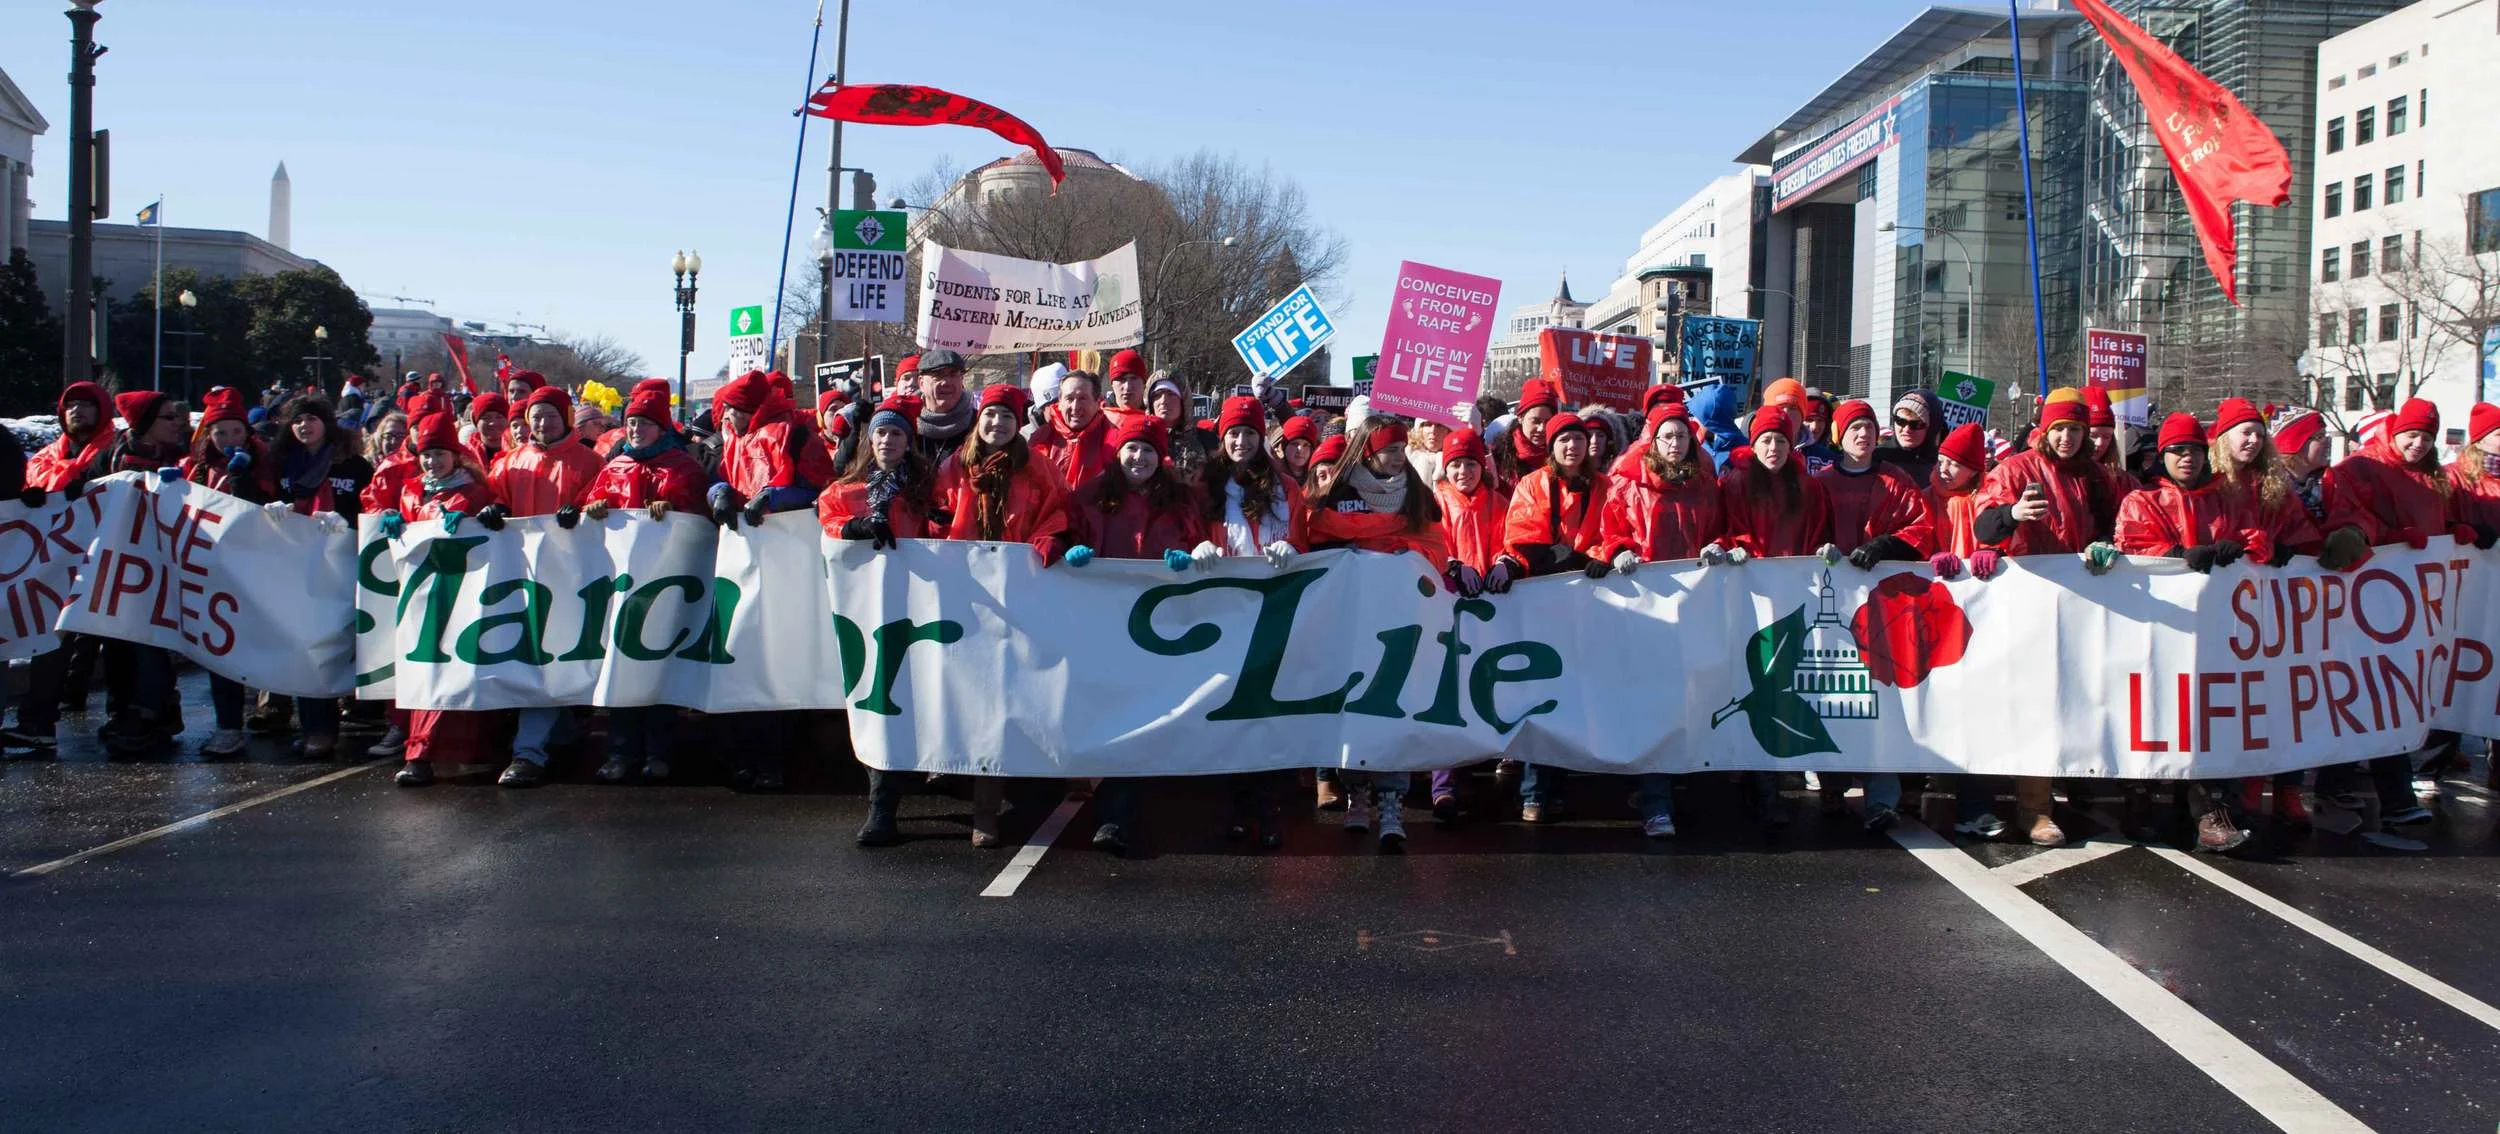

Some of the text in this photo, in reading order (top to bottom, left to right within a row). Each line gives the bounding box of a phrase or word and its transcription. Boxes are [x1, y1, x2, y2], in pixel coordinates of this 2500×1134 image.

[1780, 120, 1880, 199] NEWSEUM CELEBRATES FREEDOM
[834, 252, 904, 280] DEFEND
[850, 283, 886, 310] LIFE
[1400, 277, 1493, 306] CONCEIVED
[1419, 297, 1466, 318] FROM
[1240, 340, 1249, 350] I
[1246, 312, 1285, 346] STAND
[1282, 293, 1309, 318] FOR
[1417, 314, 1462, 334] RAPE
[730, 337, 764, 358] DEFEND
[1247, 302, 1328, 374] LIFE
[1396, 338, 1472, 364] I LOVE MY
[1700, 340, 1741, 352] FARGO
[2090, 336, 2145, 354] Life is a
[1571, 338, 1637, 369] LIFE
[1703, 356, 1745, 369] CAME
[2090, 350, 2140, 368] human
[1390, 352, 1468, 393] LIFE
[2090, 364, 2128, 381] right.
[1354, 381, 1373, 397] DEF
[130, 479, 222, 577] THE
[2229, 559, 2470, 661] SUPPORT
[1128, 567, 1563, 734] Life
[2129, 670, 2270, 753] LIFE
